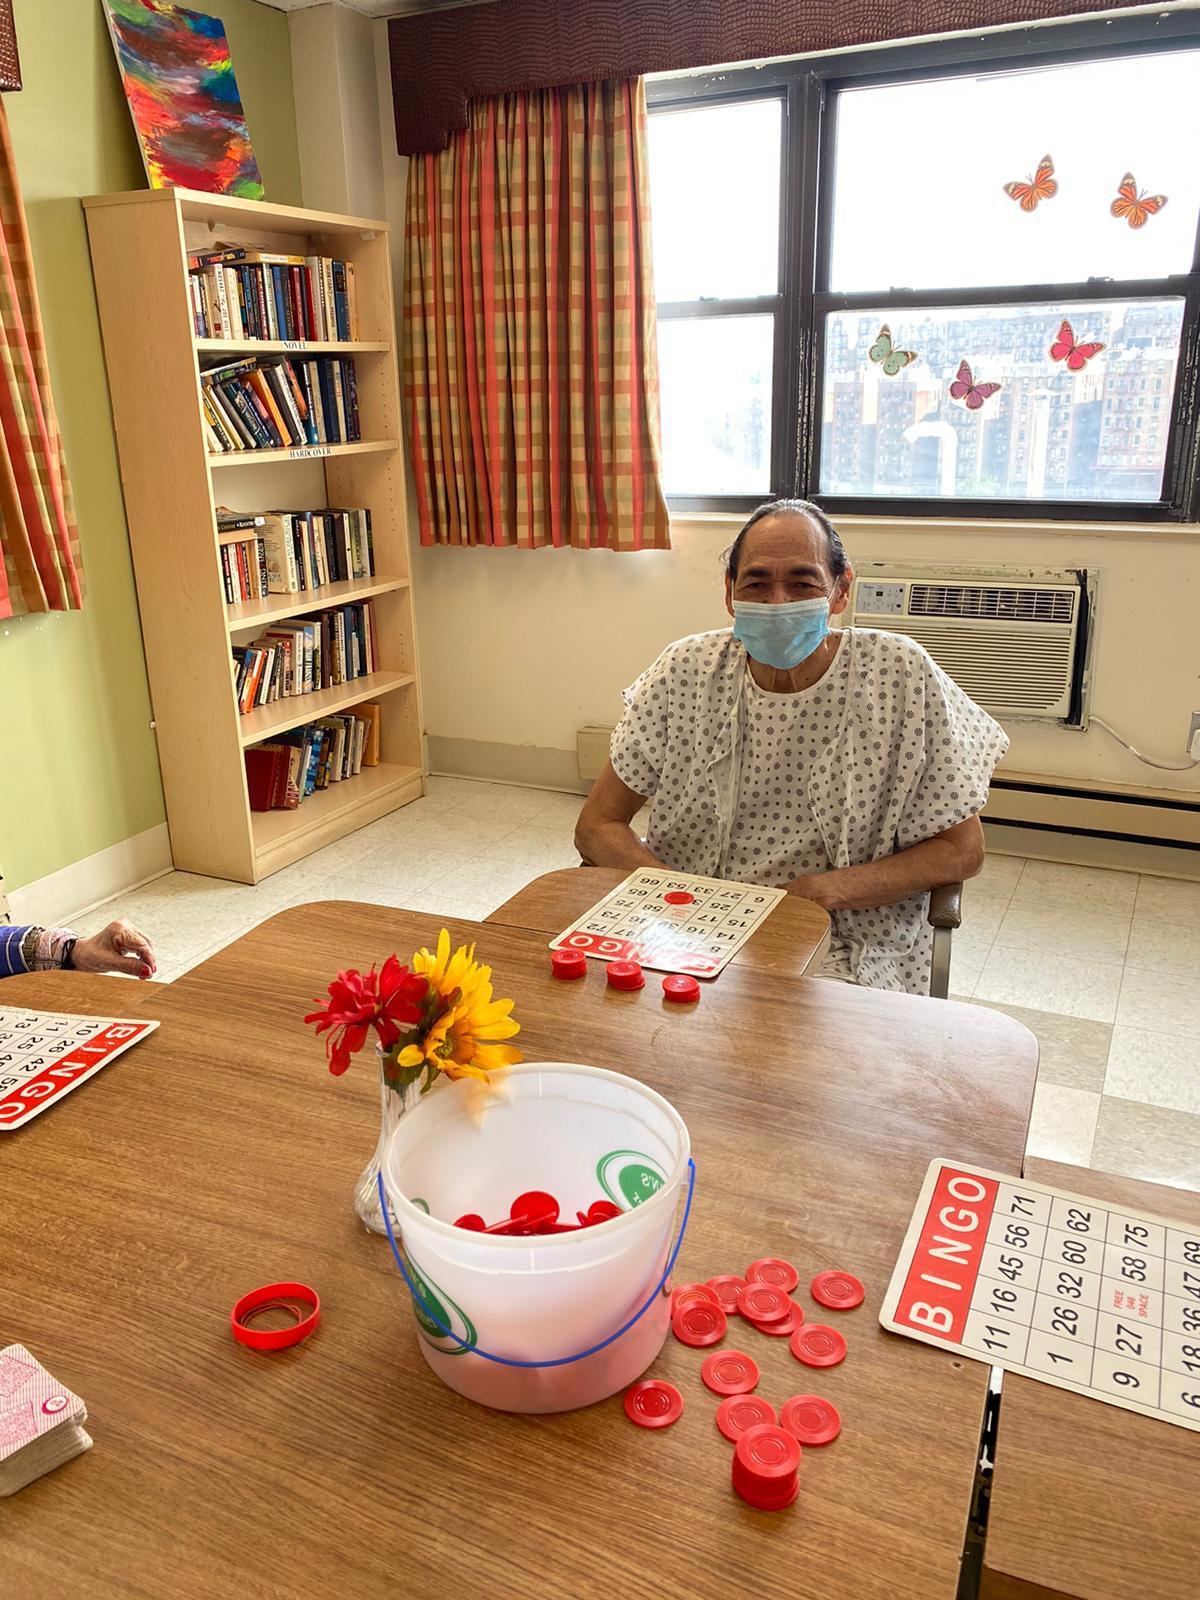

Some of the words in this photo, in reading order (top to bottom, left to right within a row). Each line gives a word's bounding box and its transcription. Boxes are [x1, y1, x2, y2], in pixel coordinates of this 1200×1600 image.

[283, 341, 307, 350] NOVEL
[289, 447, 332, 458] HARDCOVER
[640, 877, 660, 886] 66
[666, 881, 687, 890] 53
[693, 885, 715, 895] 33
[719, 890, 741, 900] 27
[614, 898, 634, 908] 75
[641, 903, 664, 913] 58
[696, 913, 718, 923] 17
[727, 918, 747, 928] 15
[710, 901, 730, 911] 25
[586, 922, 608, 932] 72
[601, 910, 622, 920] 73
[686, 925, 706, 935] 16
[716, 931, 737, 941] 14
[76, 1023, 99, 1036] 10
[17, 1036, 44, 1050] 25
[48, 1040, 75, 1053] 26
[0, 1026, 139, 1119] BINGO
[18, 1057, 45, 1072] 42
[1011, 1196, 1035, 1215] 71
[1067, 1209, 1090, 1232] 62
[1005, 1225, 1029, 1248] 56
[1125, 1224, 1148, 1247] 75
[907, 1176, 987, 1334] BINGO
[1062, 1241, 1086, 1264] 60
[998, 1255, 1023, 1280] 45
[1122, 1257, 1146, 1281] 58
[1057, 1273, 1082, 1298] 32
[991, 1289, 1017, 1311] 16
[1113, 1289, 1124, 1309] FREE
[1138, 1293, 1149, 1318] SPACE
[1052, 1307, 1078, 1335] 26
[983, 1326, 1009, 1348] 11
[1116, 1324, 1142, 1355] 27
[1048, 1353, 1072, 1362] 1
[1113, 1372, 1139, 1387] 9
